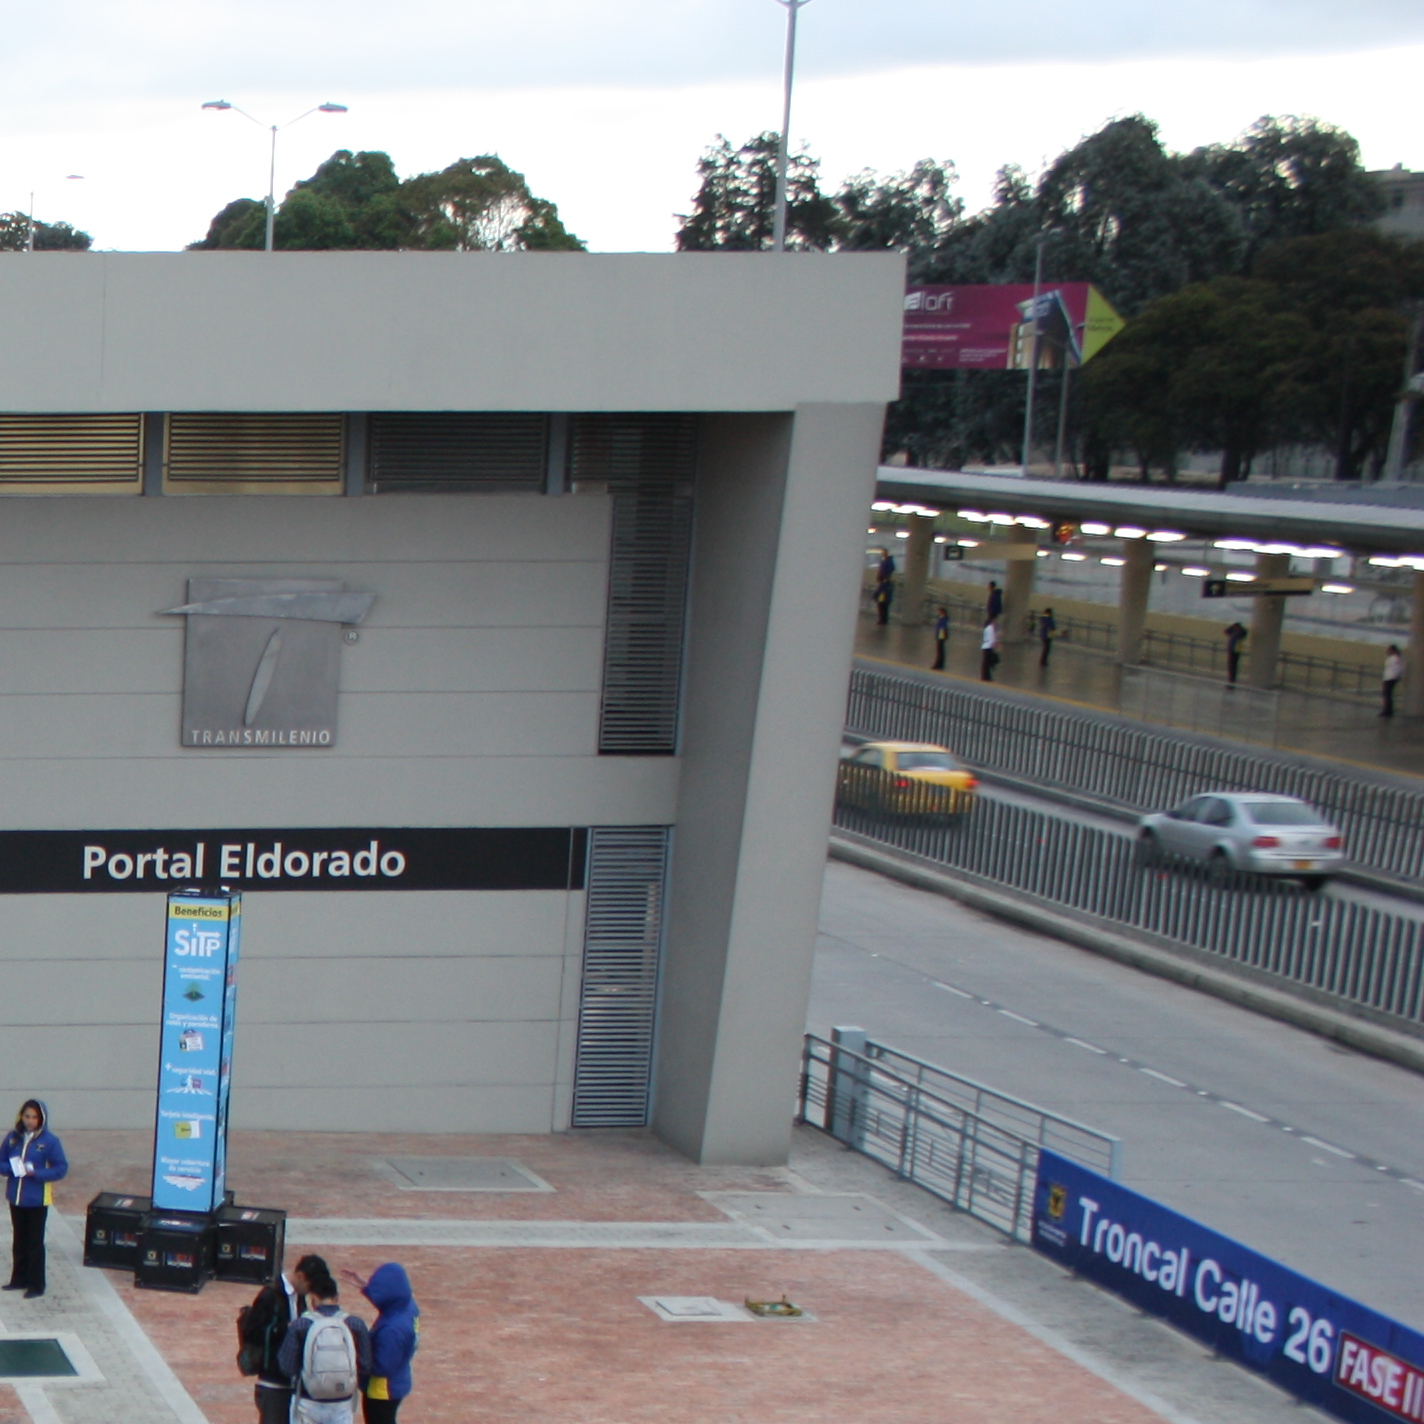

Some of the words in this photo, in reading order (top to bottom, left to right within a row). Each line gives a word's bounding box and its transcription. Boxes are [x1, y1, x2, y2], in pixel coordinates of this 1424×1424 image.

[191, 730, 331, 745] TRANSMILENIO
[82, 842, 205, 880] Portal
[219, 840, 406, 878] Eldorado
[174, 905, 223, 918] Beneficios
[1078, 1196, 1188, 1297] Troncal
[1194, 1258, 1277, 1344] Calle
[1283, 1306, 1334, 1374] 26
[1340, 1339, 1402, 1407] FASE
